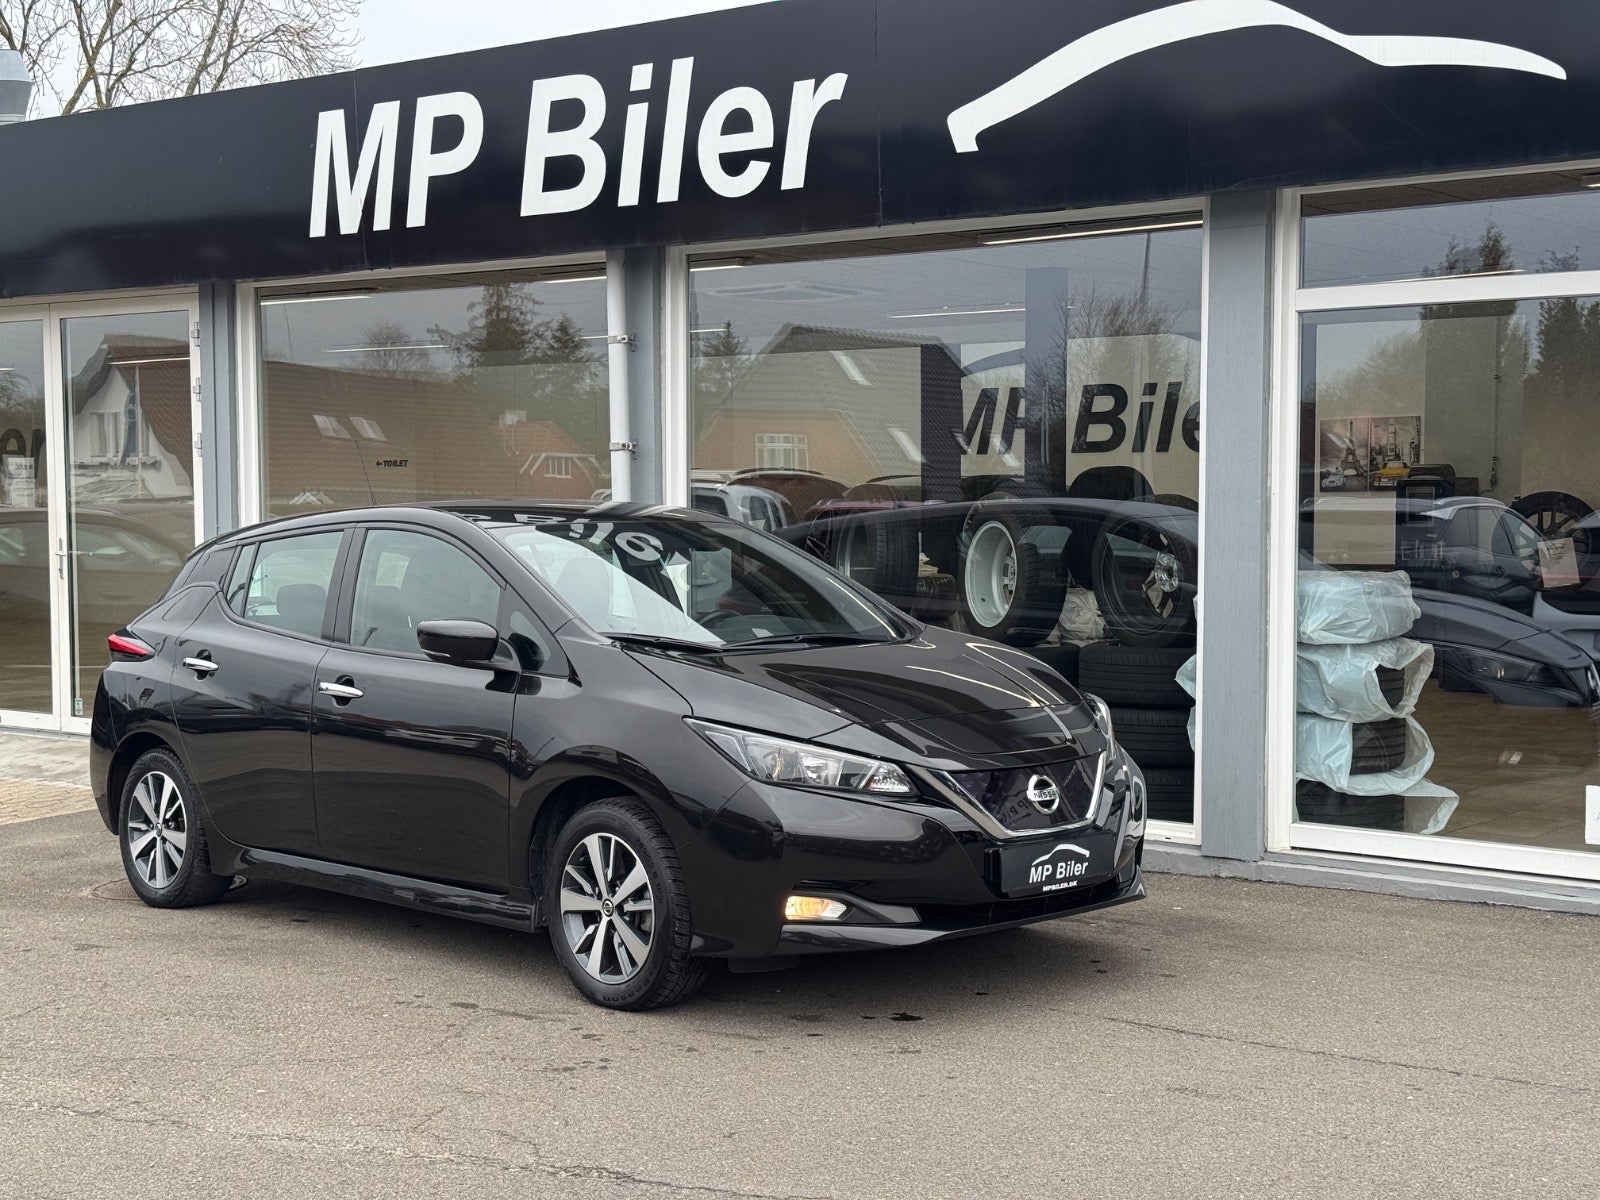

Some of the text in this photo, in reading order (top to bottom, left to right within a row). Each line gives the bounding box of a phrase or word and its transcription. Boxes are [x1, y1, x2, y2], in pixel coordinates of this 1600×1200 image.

[309, 56, 848, 238] MP Biler
[383, 459, 409, 468] TOILET
[1029, 860, 1089, 884] MP Biler
